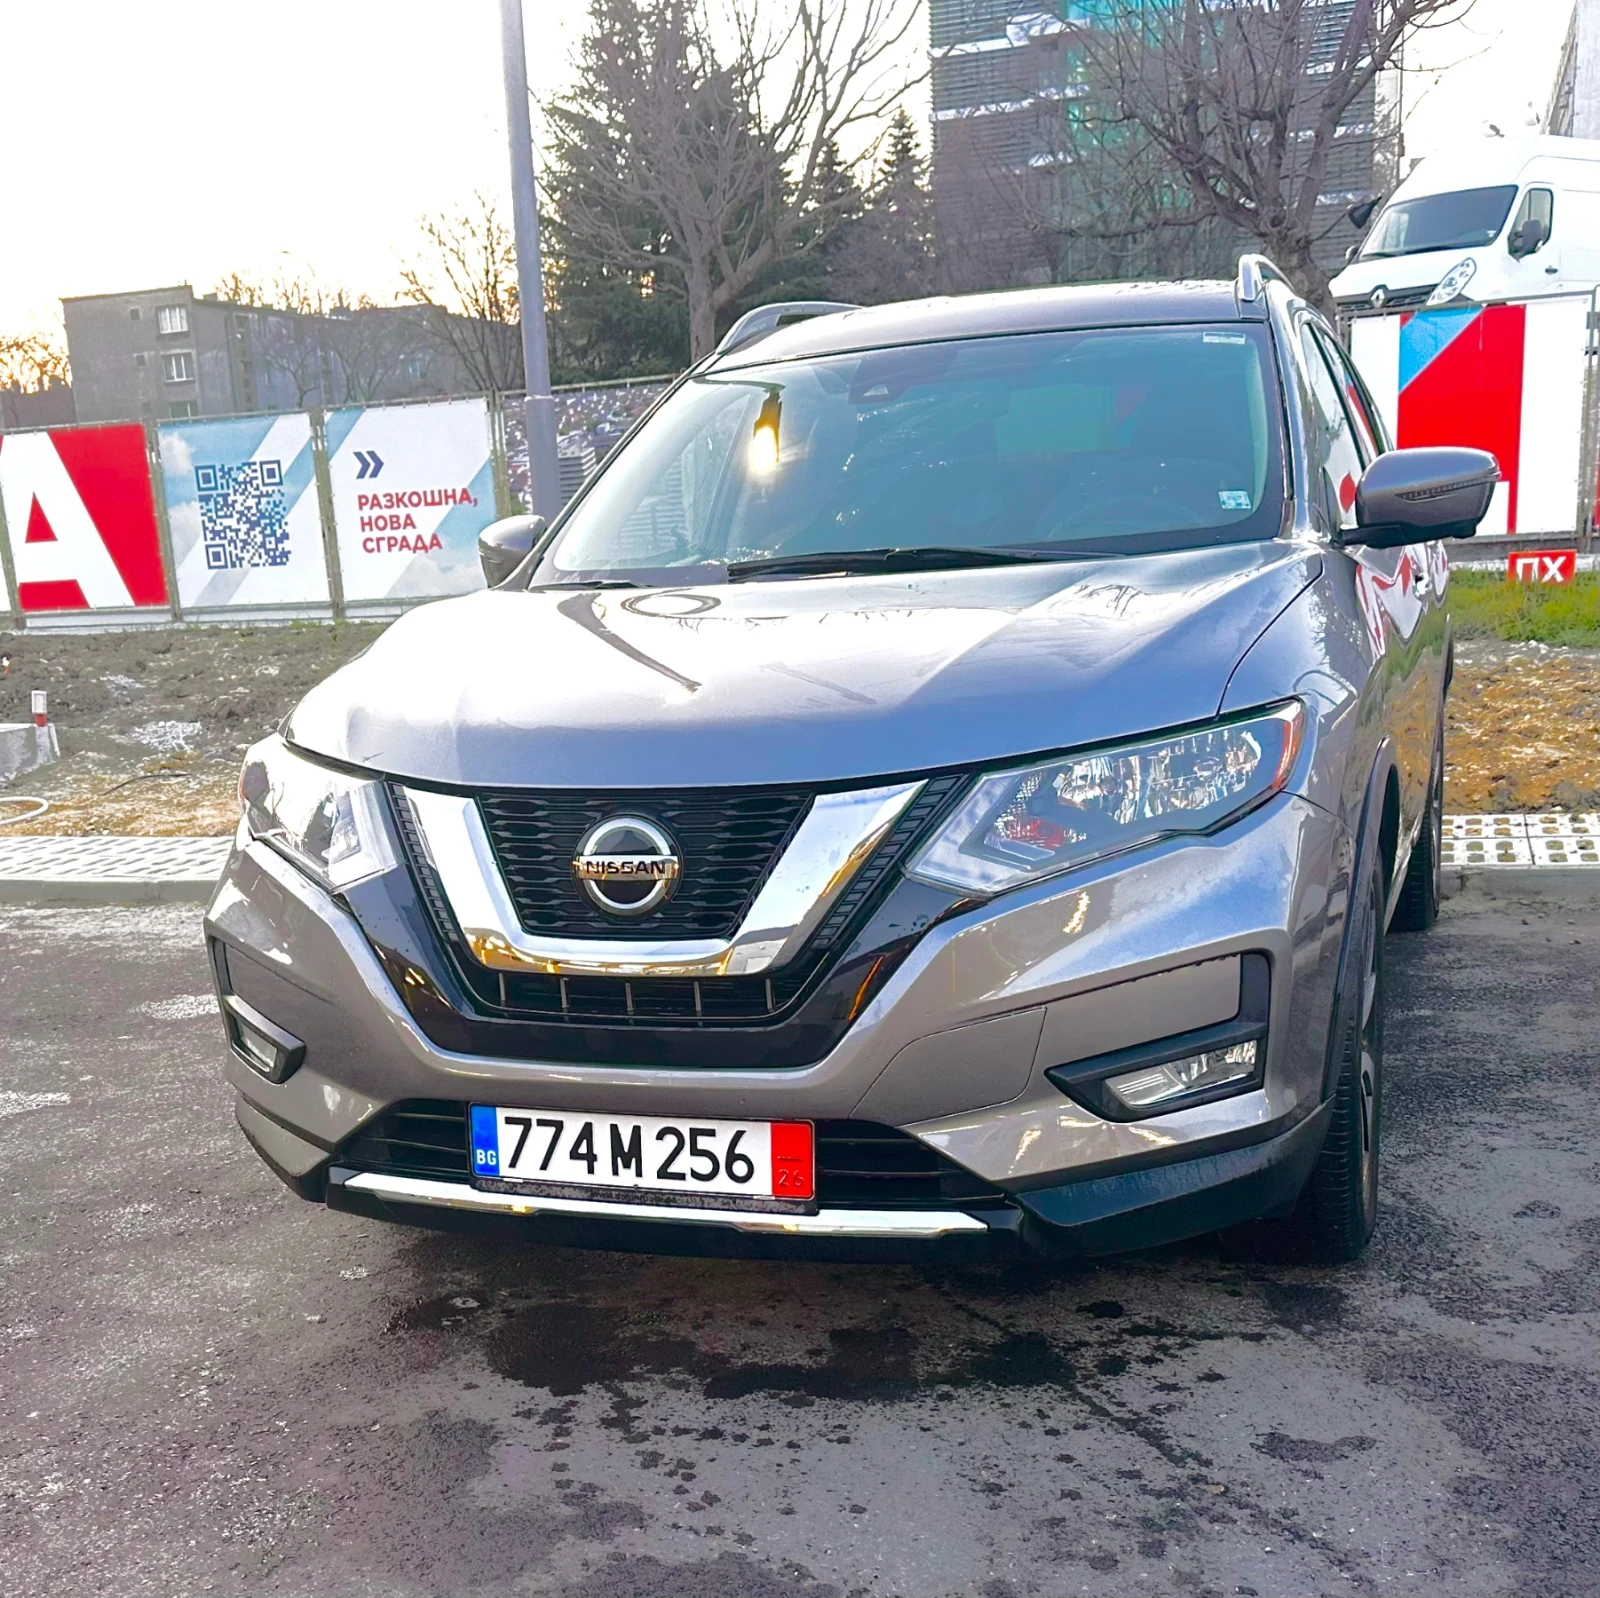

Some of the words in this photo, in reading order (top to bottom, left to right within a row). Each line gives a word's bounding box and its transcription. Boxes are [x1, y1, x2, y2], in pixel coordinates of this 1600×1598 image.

[357, 487, 479, 511] РАЗКОШНА,
[360, 513, 417, 532] НОВА
[362, 533, 443, 554] СГРАДА
[1516, 556, 1566, 583] ПХ
[586, 861, 665, 874] NISSAN
[476, 1149, 497, 1166] BG
[778, 1168, 804, 1187] 26
